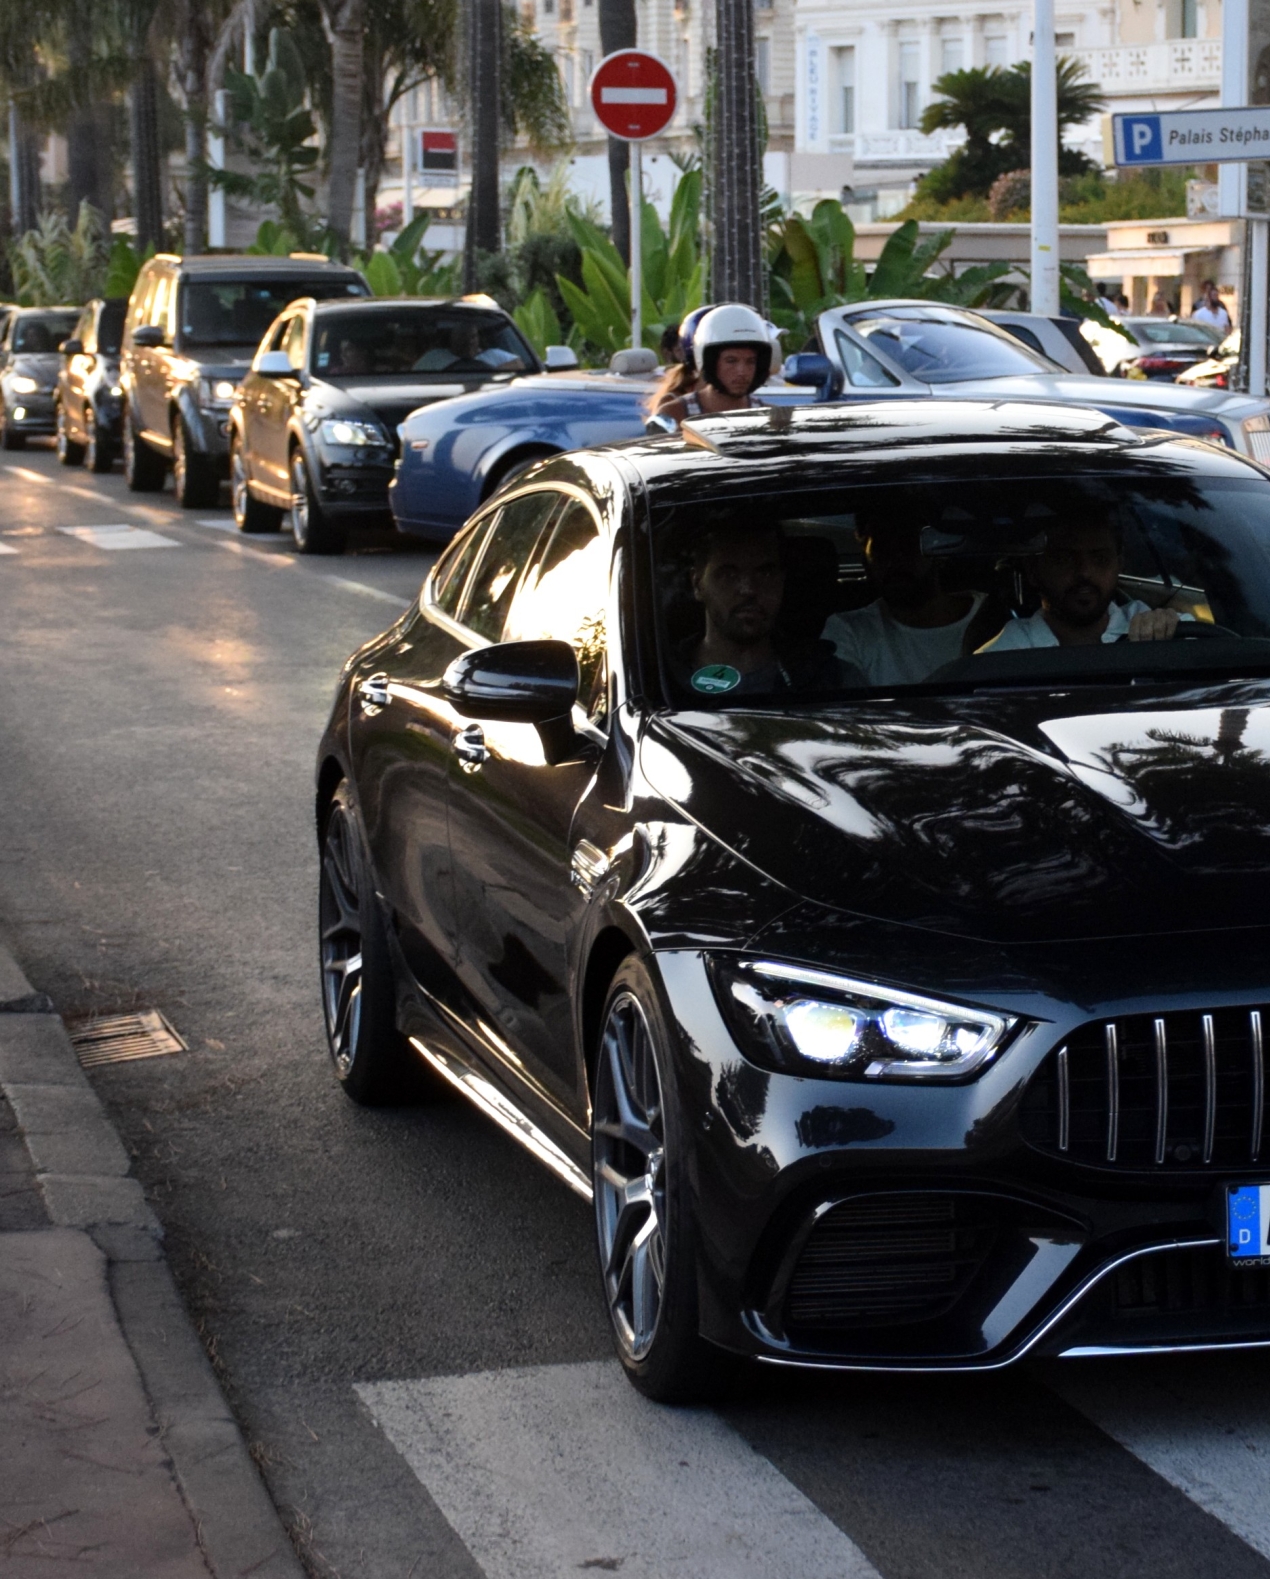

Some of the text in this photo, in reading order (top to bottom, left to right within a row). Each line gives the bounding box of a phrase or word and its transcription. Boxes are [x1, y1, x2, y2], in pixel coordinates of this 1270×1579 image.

[1132, 122, 1153, 155] P
[1169, 129, 1213, 145] Palais
[1239, 1228, 1251, 1244] D
